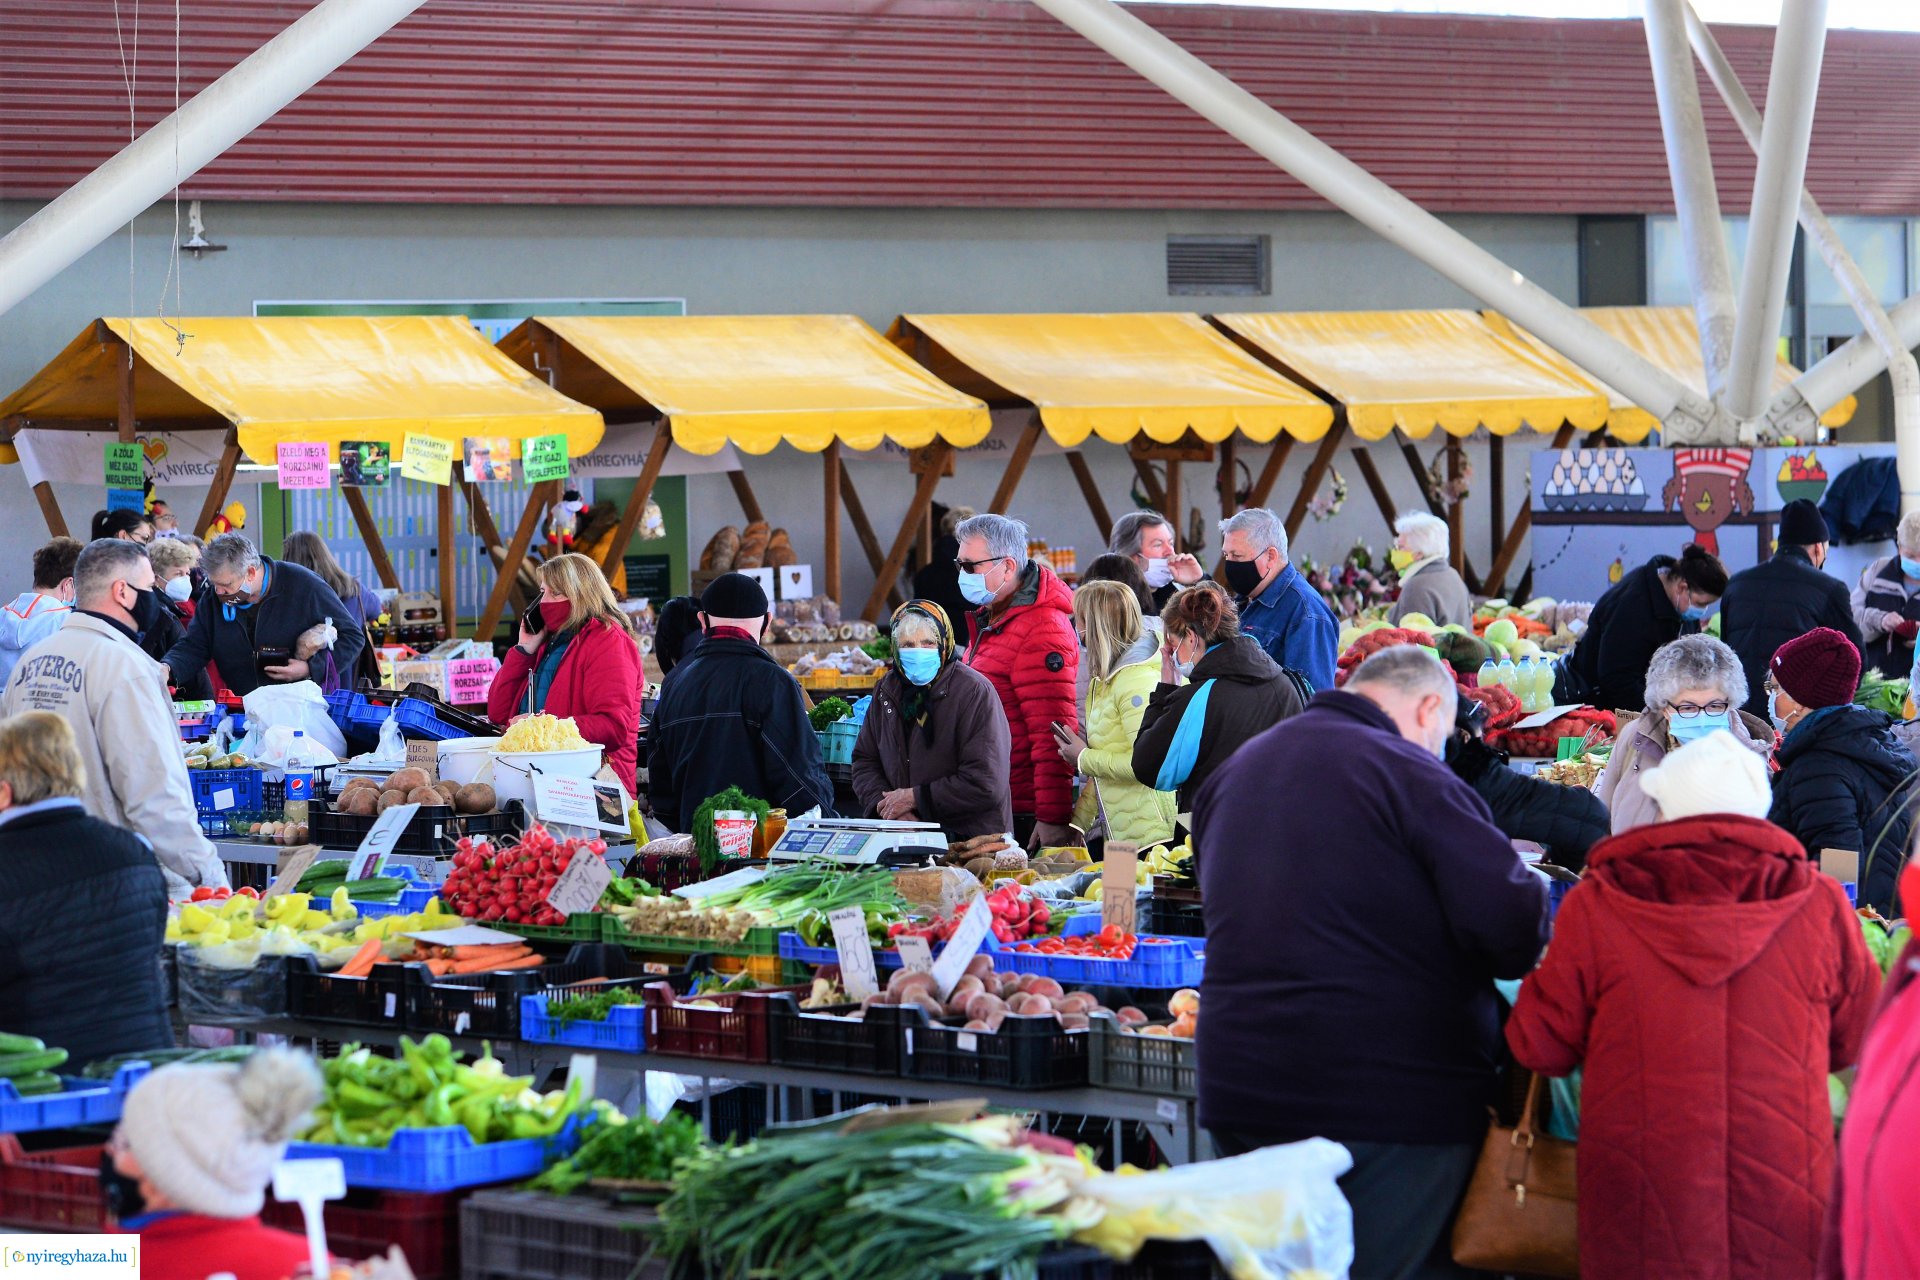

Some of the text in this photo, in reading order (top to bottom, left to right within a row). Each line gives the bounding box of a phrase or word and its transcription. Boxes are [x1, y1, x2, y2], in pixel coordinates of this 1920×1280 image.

[113, 448, 117, 458] A
[304, 447, 320, 457] MEG
[321, 447, 326, 457] A
[577, 452, 649, 468] NYÍREGYHÁ
[167, 460, 214, 476] NYÍREG
